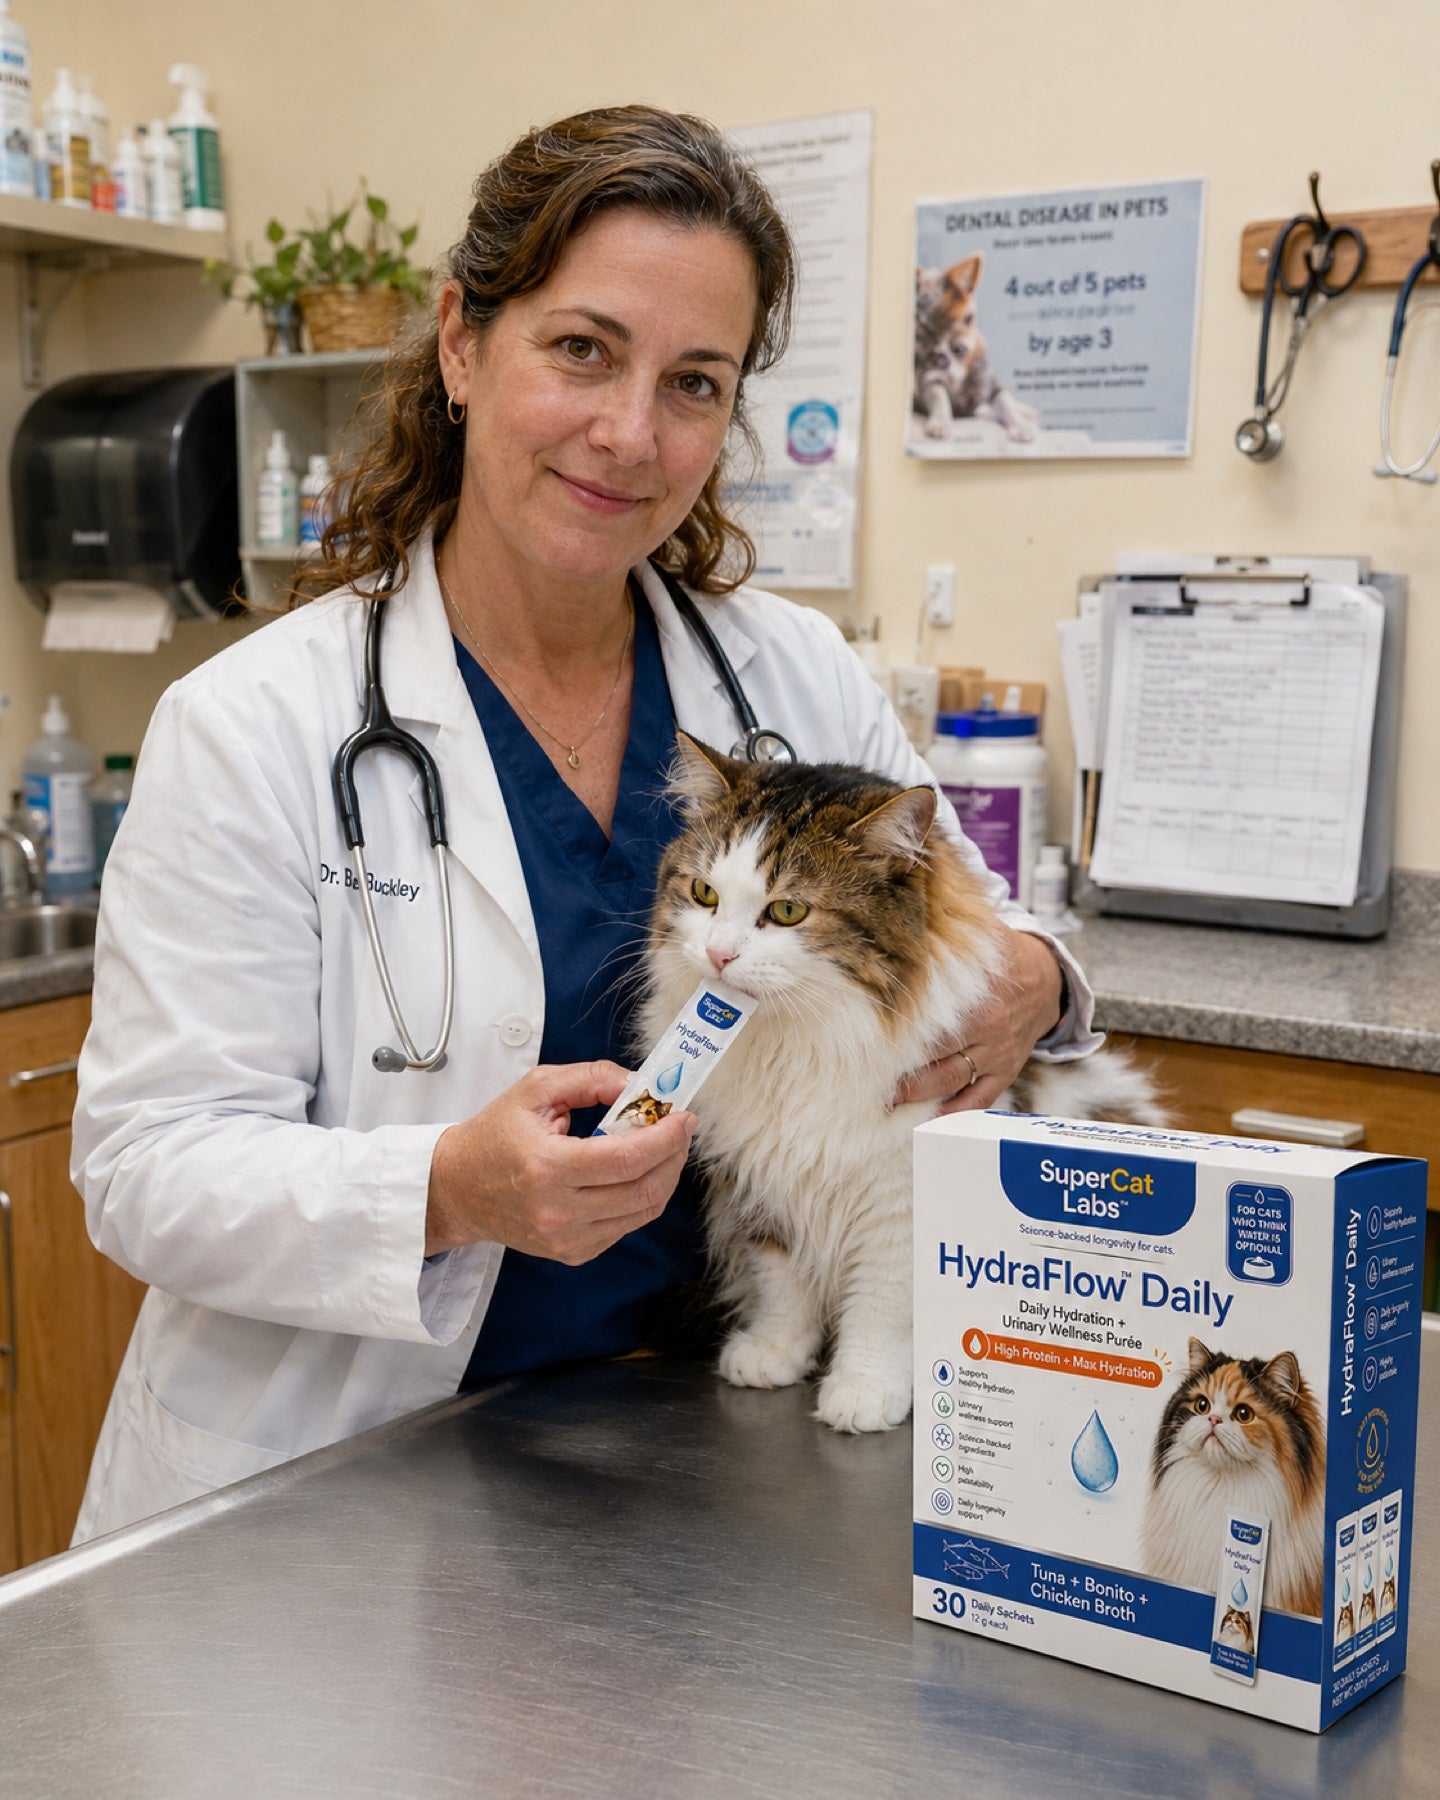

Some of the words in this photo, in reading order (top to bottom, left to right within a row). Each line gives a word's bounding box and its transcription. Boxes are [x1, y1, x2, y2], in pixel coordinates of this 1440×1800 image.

[946, 208, 1013, 233] DENTAL
[1019, 202, 1093, 227] DISEASE
[1101, 201, 1118, 220] IN
[1125, 197, 1168, 218] PETS
[1004, 275, 1018, 297] 4
[1023, 277, 1054, 298] out
[1059, 273, 1079, 294] of
[1085, 272, 1098, 293] 5
[1104, 273, 1146, 297] pets
[1028, 332, 1053, 355] by
[1057, 334, 1093, 354] age
[1099, 327, 1112, 349] 3
[320, 863, 339, 885] Dr.
[1040, 1158, 1155, 1195] SuperCat
[1257, 1207, 1282, 1219] CATS
[1019, 1223, 1091, 1243] Science-backed
[1093, 1235, 1136, 1251] longevity
[1138, 1240, 1152, 1251] for
[1153, 1242, 1175, 1255] cats.
[1346, 1208, 1361, 1269] Daily
[1019, 1300, 1050, 1318] Daily
[1053, 1306, 1115, 1328] Hydration
[1118, 1318, 1126, 1328] +
[1142, 1272, 1234, 1327] Daily
[1002, 1315, 1046, 1336] Urinary
[1049, 1321, 1103, 1344] Wellness
[1106, 1332, 1142, 1350] Purée
[994, 1342, 1020, 1359] High
[1023, 1347, 1060, 1365] Protein
[1073, 1355, 1097, 1372] Max
[1100, 1361, 1156, 1381] Hydration
[1031, 1562, 1065, 1586] Tuna
[1070, 1578, 1080, 1588] +
[1085, 1577, 1134, 1603] Bonito
[1139, 1594, 1148, 1605] +
[932, 1587, 966, 1619] 30
[971, 1598, 995, 1616] Daily
[997, 1606, 1035, 1626] Sachets
[971, 1613, 980, 1623] 12
[1030, 1583, 1091, 1611] Chicken
[1095, 1600, 1136, 1623] Broth
